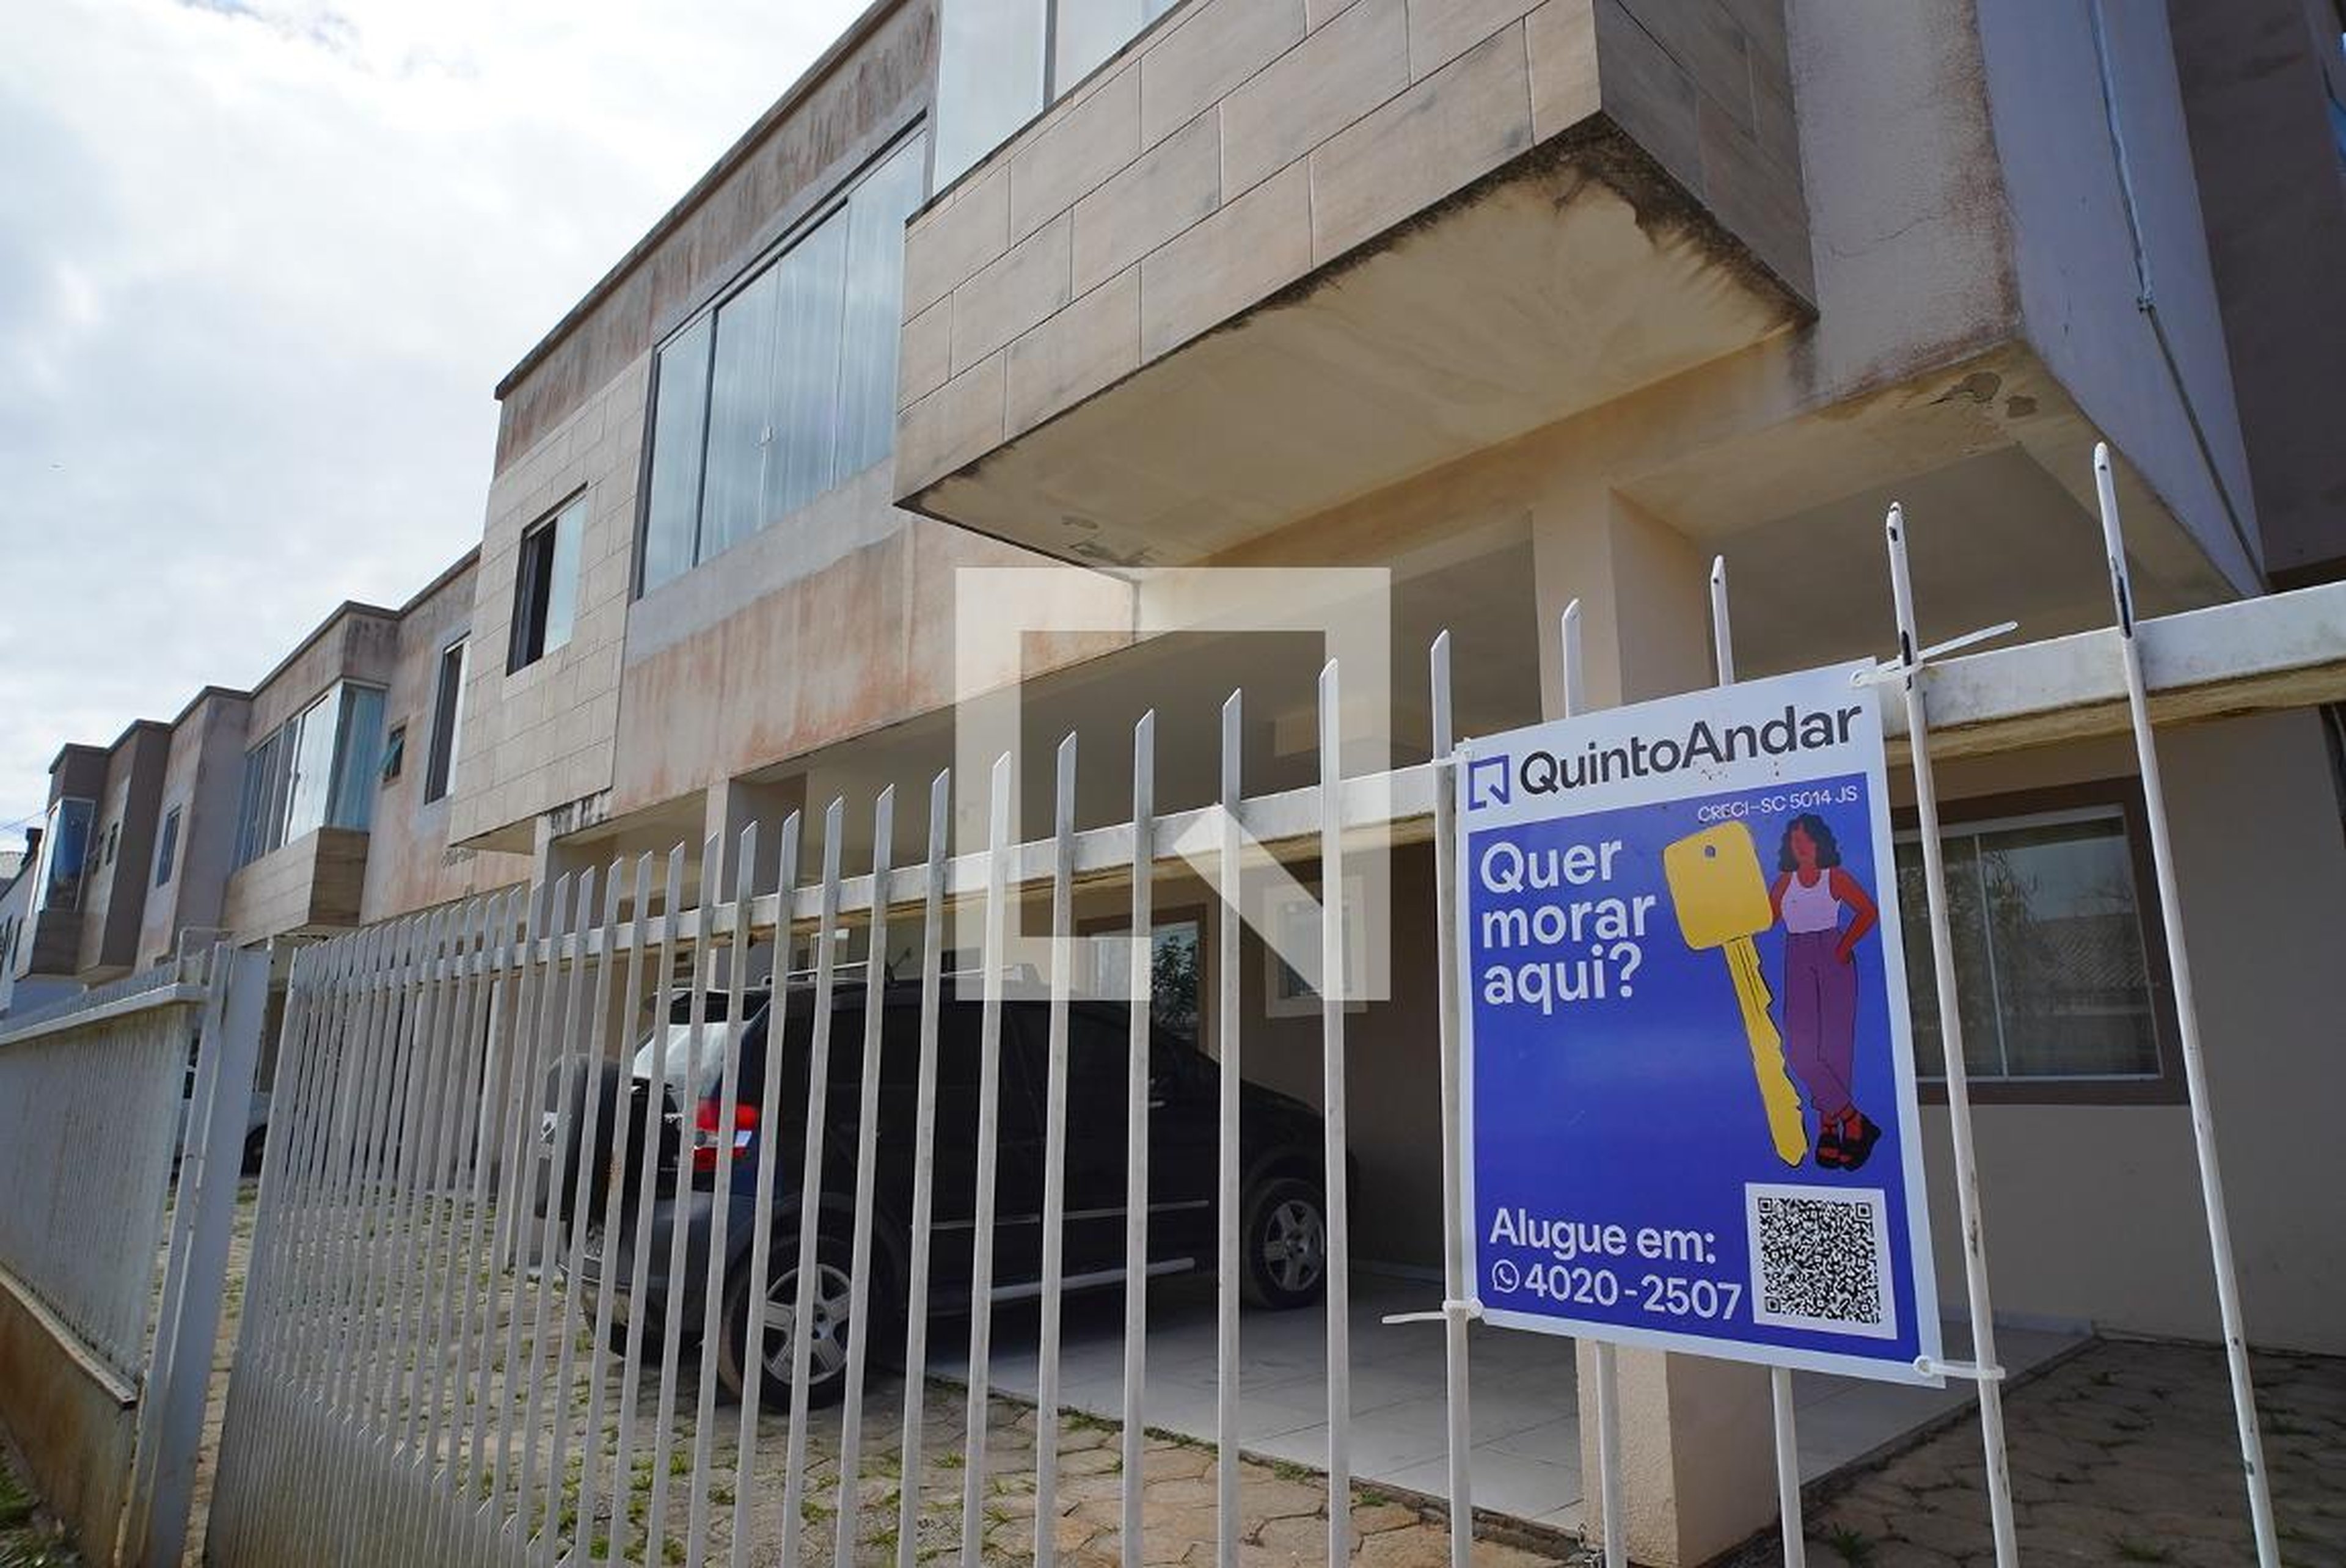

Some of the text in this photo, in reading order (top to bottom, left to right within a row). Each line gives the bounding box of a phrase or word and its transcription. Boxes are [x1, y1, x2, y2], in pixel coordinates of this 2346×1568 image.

[1520, 705, 1862, 795] QuintoAndar
[1790, 790, 1832, 809] 5014
[1835, 786, 1857, 803] JS
[1480, 841, 1622, 893] Quer
[1483, 895, 1656, 948] morar
[1485, 942, 1642, 1015] aqui?
[1490, 1208, 1716, 1264] Alugue em:
